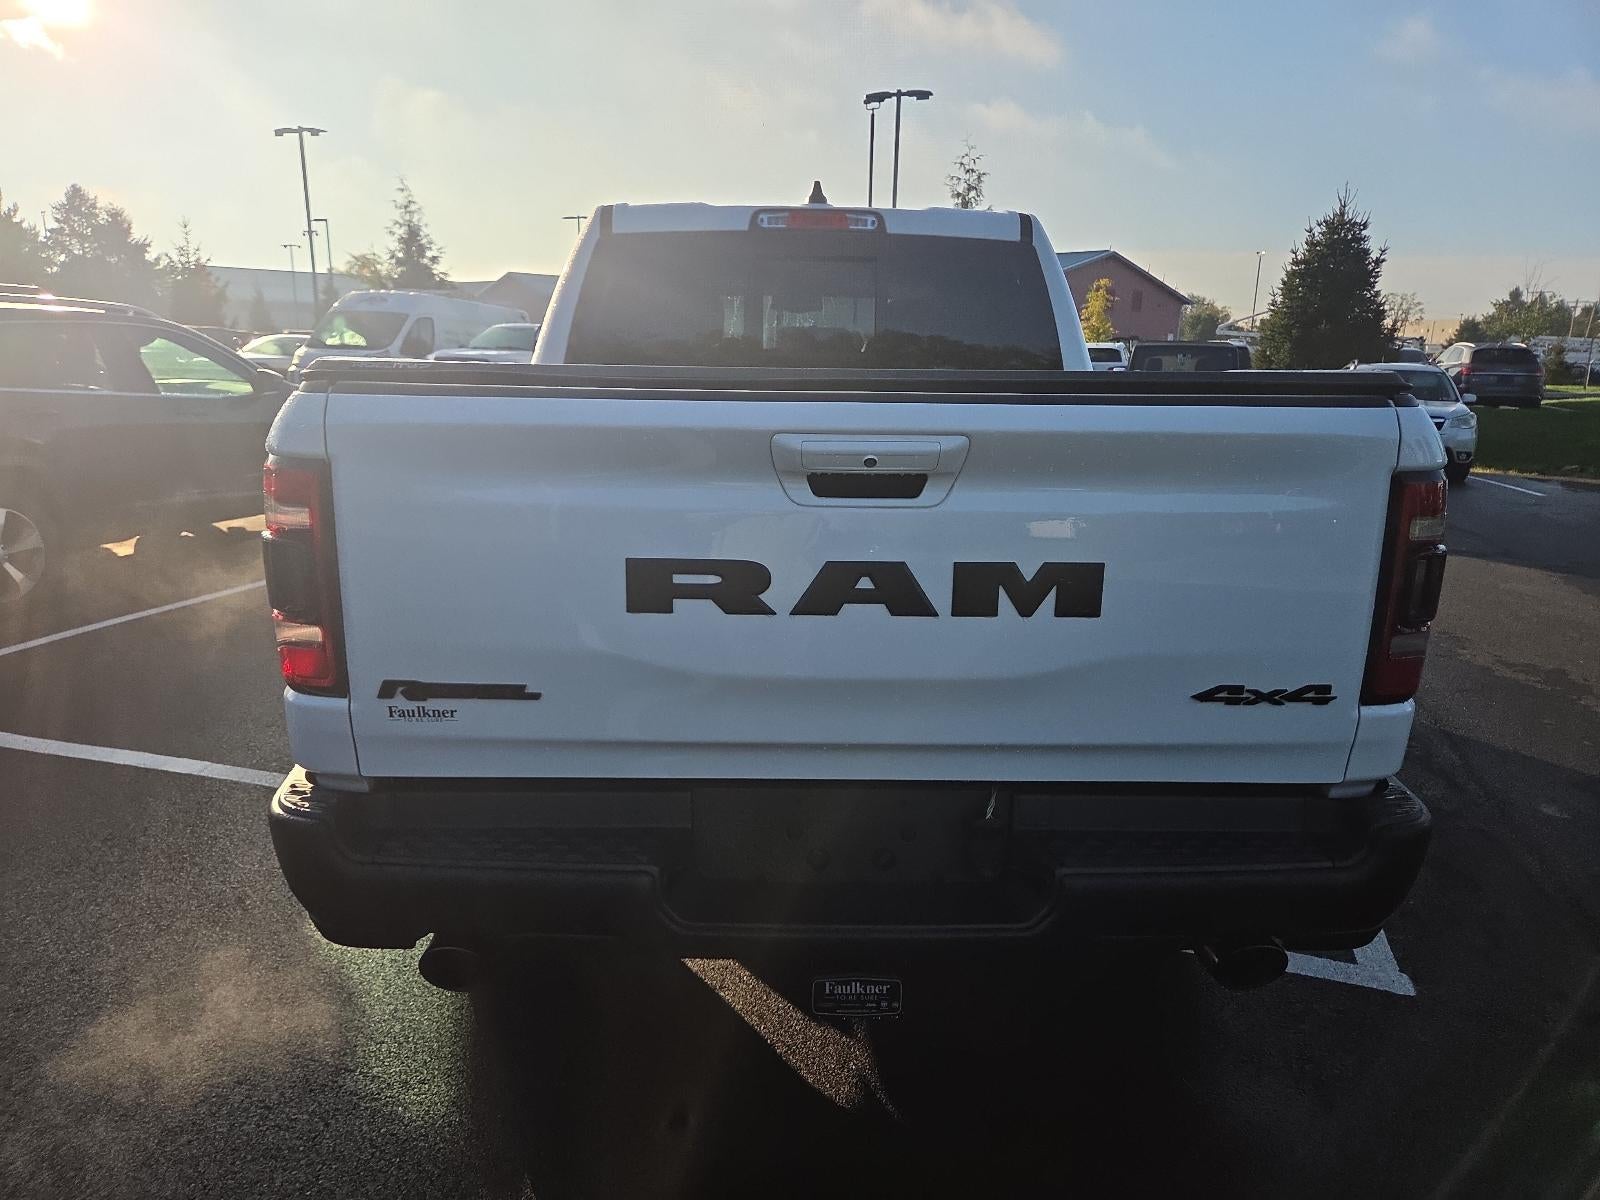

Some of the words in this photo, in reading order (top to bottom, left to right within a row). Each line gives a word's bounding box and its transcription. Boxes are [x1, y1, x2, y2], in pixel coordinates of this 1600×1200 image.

[625, 557, 1105, 618] RAM
[1189, 684, 1338, 706] 4x4
[387, 705, 458, 718] Faulkner
[824, 982, 891, 994] Faulkner
